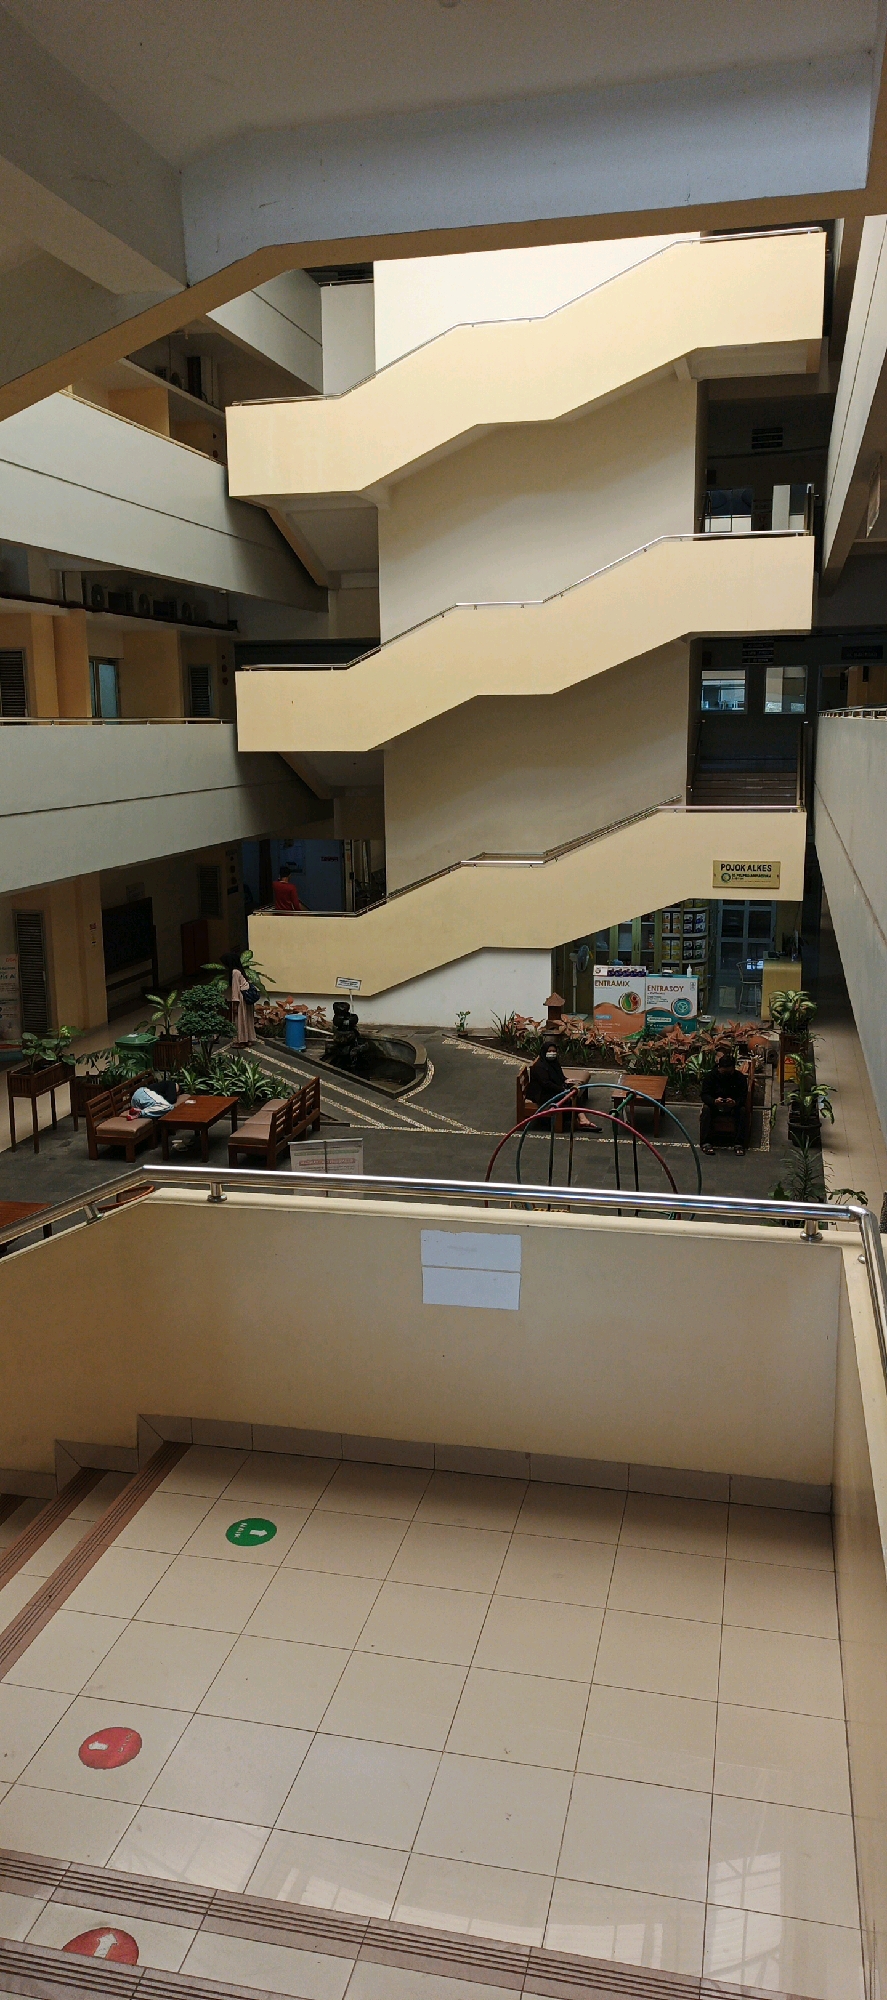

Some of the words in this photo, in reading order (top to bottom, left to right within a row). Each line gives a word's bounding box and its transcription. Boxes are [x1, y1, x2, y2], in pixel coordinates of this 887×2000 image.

[720, 863, 746, 872] POJOK
[747, 864, 772, 872] ALKES
[234, 1522, 248, 1539] NAIK
